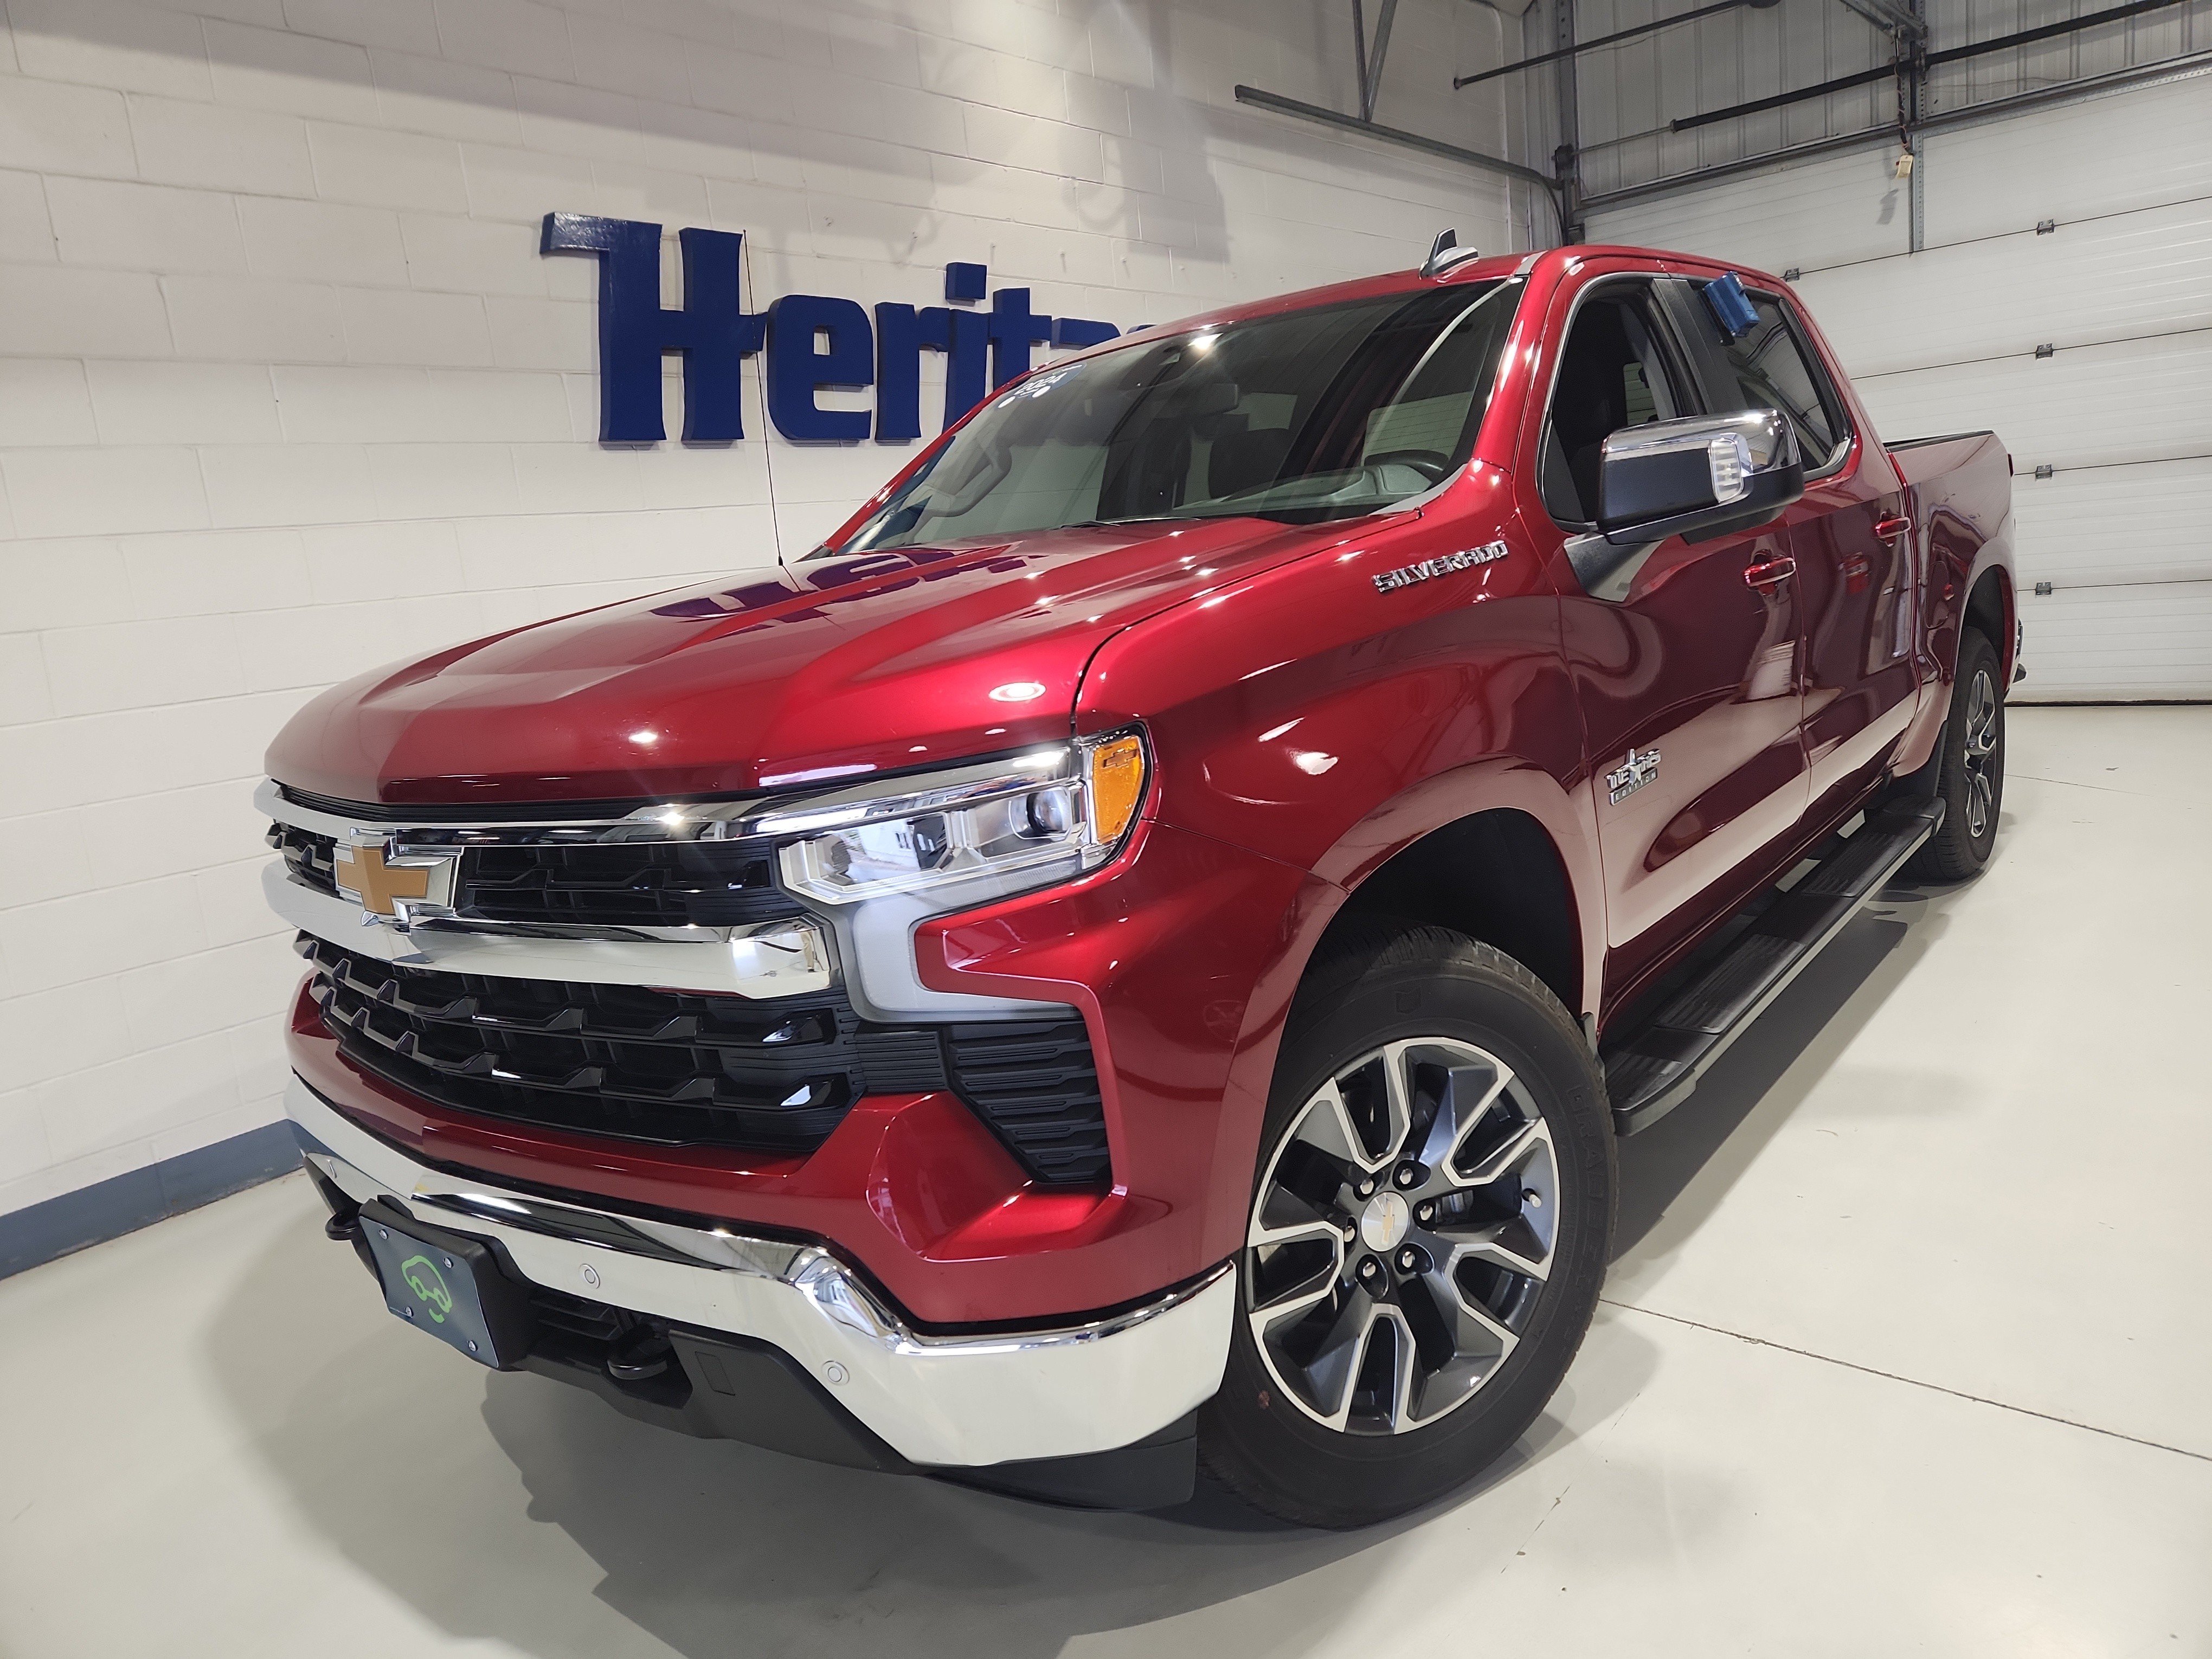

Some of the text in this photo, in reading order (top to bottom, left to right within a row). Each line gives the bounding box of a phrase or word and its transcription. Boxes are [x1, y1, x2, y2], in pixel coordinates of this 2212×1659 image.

[541, 211, 1159, 443] Herit
[1013, 372, 1068, 395] 2024
[1372, 541, 1509, 592] SILVERADO
[1615, 771, 1657, 800] EDITION
